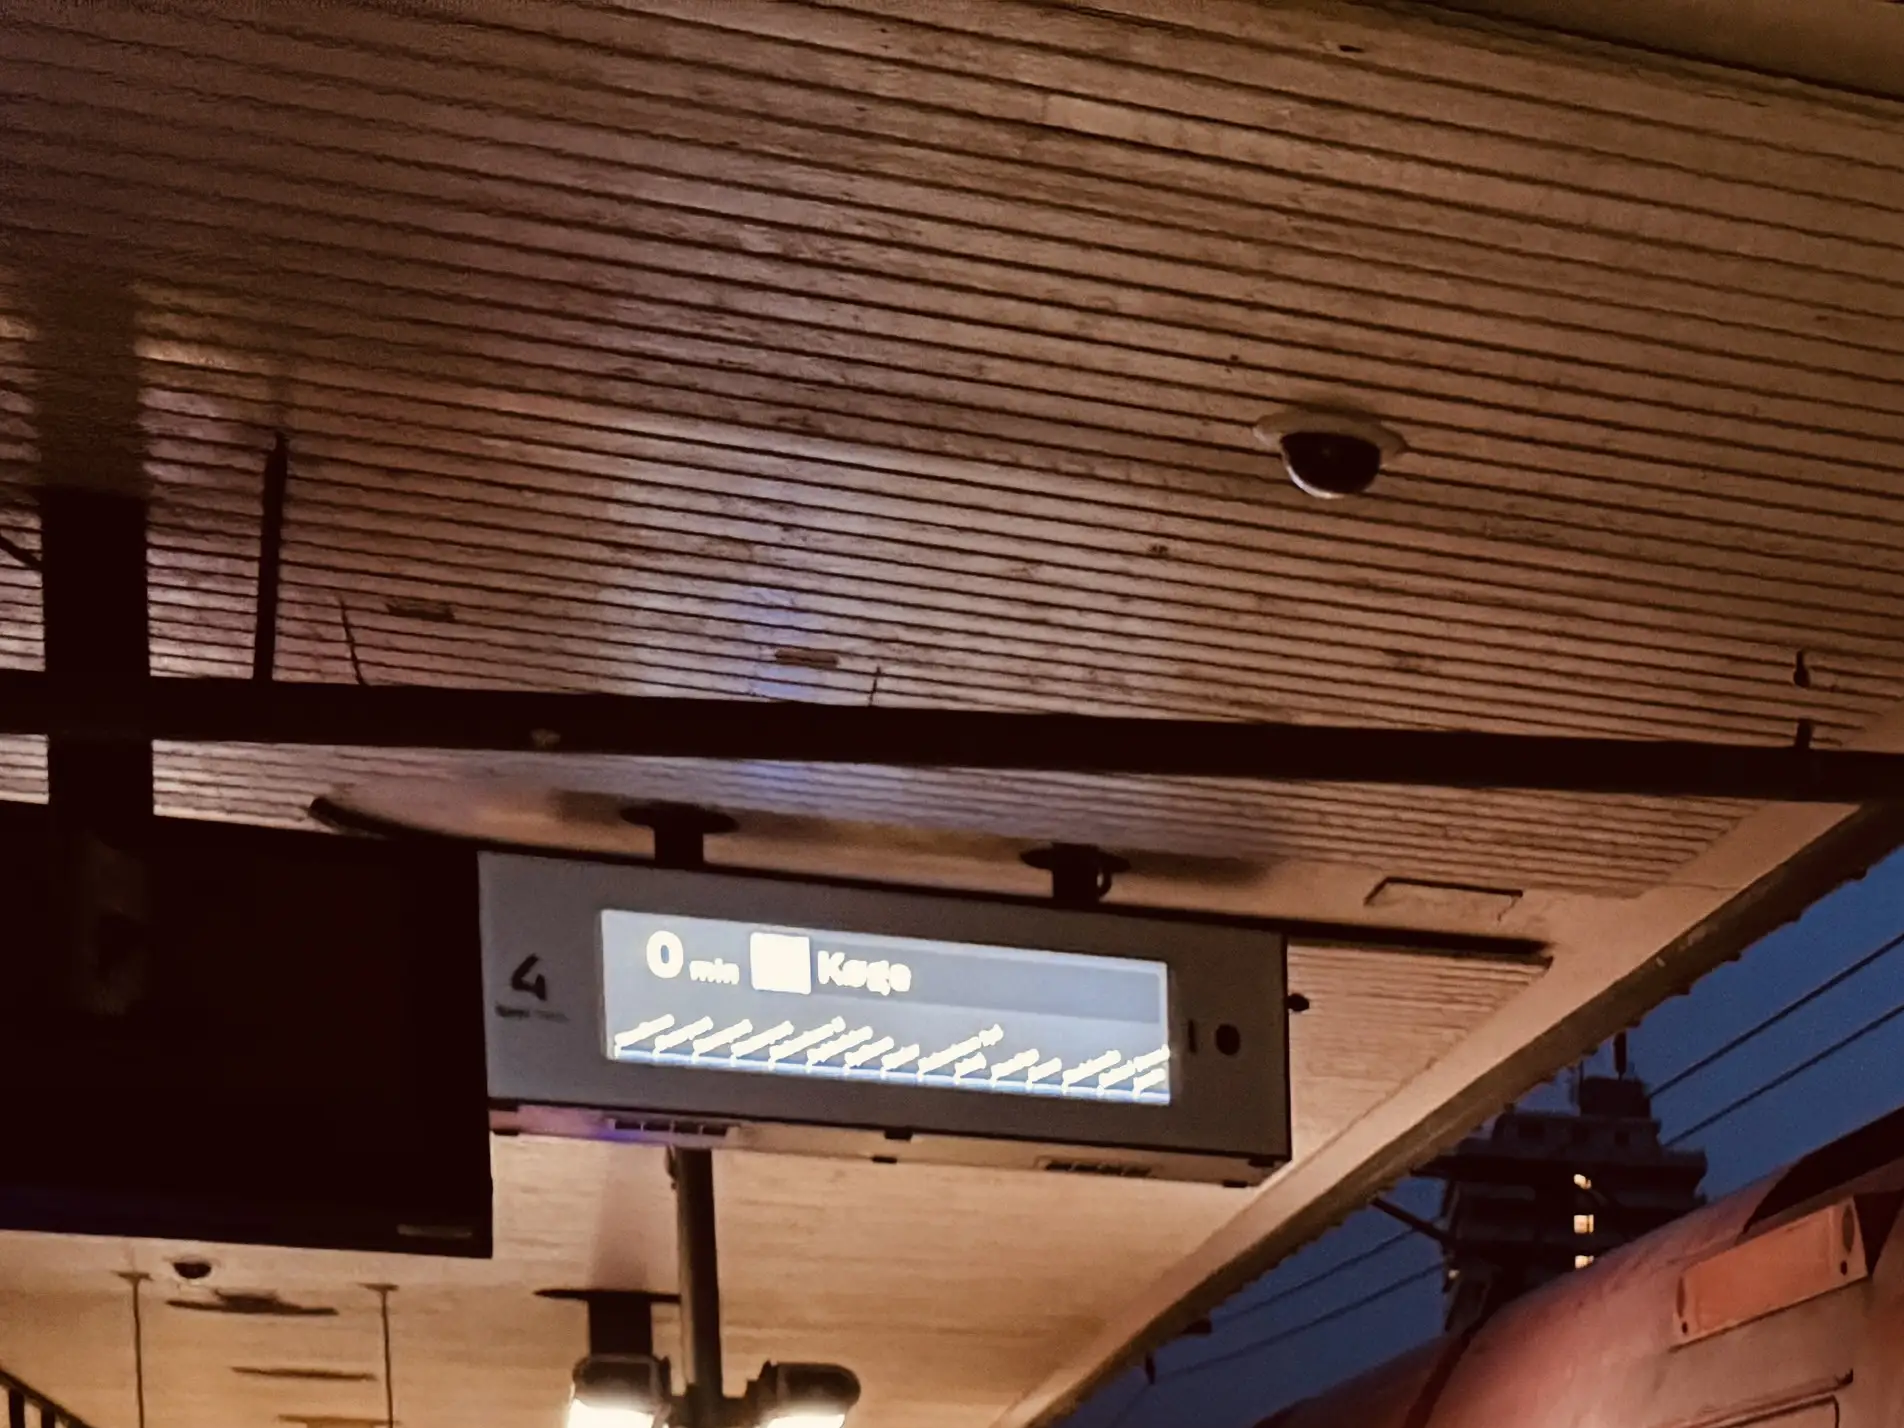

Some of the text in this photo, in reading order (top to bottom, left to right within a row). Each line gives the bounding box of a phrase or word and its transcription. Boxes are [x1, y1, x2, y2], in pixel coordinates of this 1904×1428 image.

[511, 952, 548, 1002] 4
[646, 930, 684, 979] 0
[689, 958, 740, 985] min
